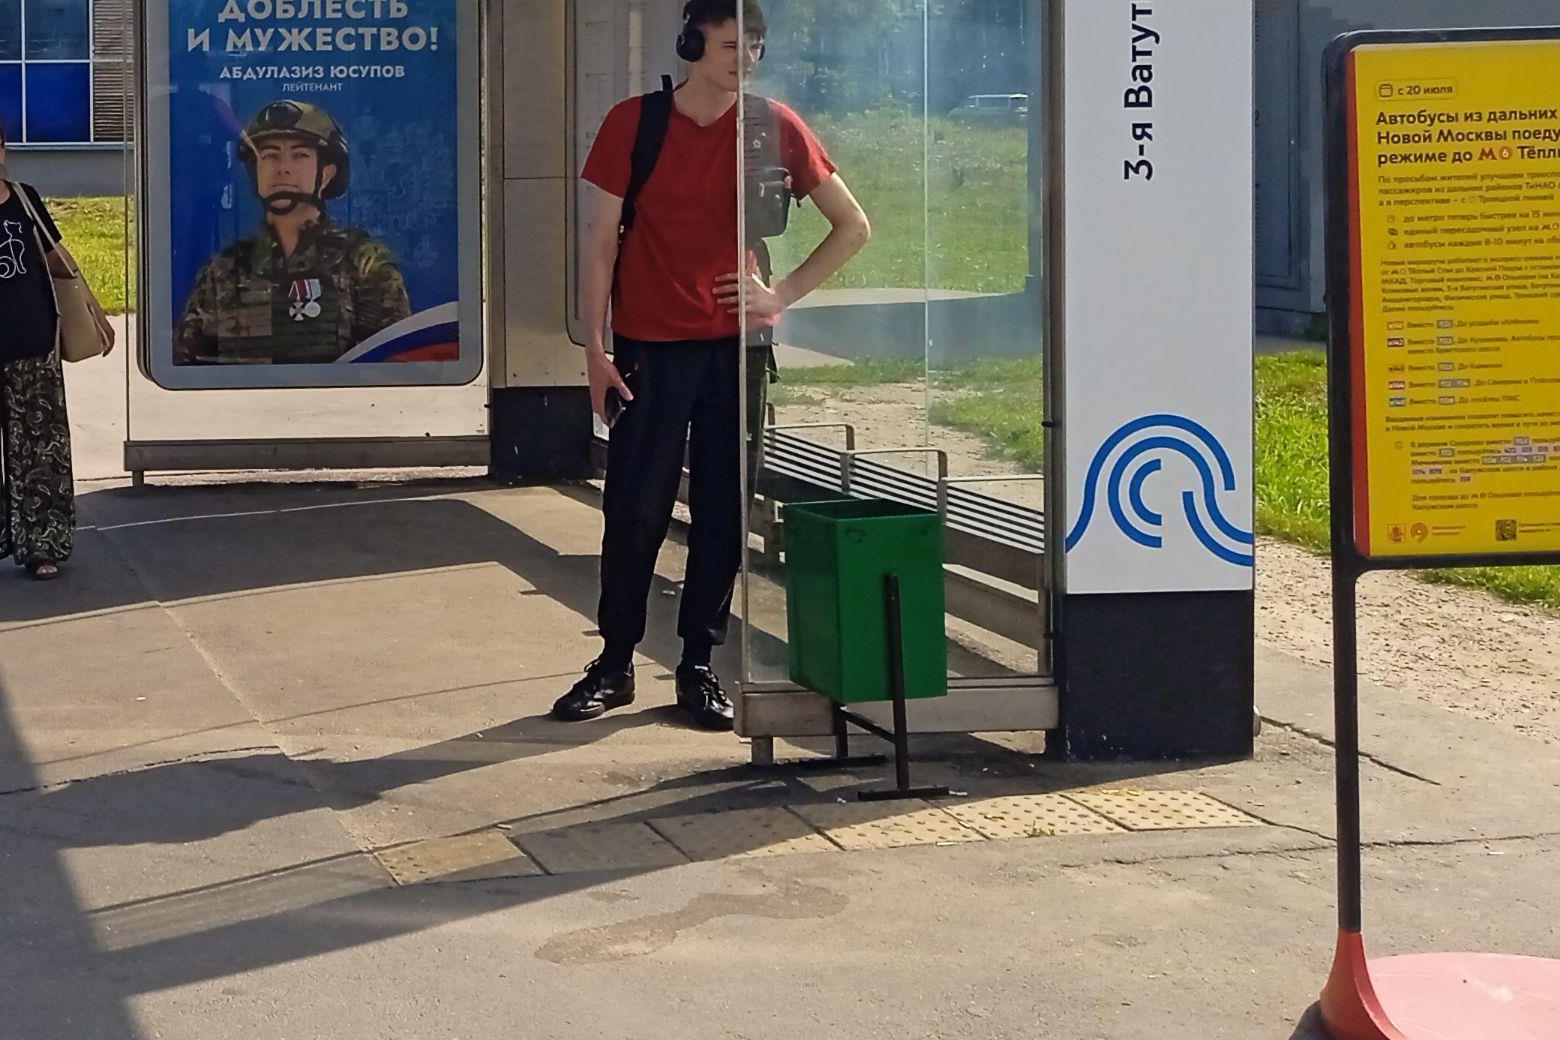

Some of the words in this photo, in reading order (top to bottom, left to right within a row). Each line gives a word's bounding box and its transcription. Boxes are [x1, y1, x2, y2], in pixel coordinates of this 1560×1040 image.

[187, 27, 210, 52] И
[225, 26, 438, 52] МУЖЕСТВО!
[219, 65, 324, 80] АБДУЛАЗИЗ
[330, 64, 406, 78] ЮСУПОВ
[282, 81, 343, 92] ЛЕЙТЕНАНТ
[1397, 87, 1404, 95] с
[1406, 85, 1421, 95] 20
[1423, 85, 1453, 94] июля
[1376, 109, 1459, 127] Автобусы
[1464, 111, 1483, 122] из
[1487, 109, 1558, 123] дальних
[1377, 129, 1433, 145] Новой
[1436, 128, 1507, 143] Москвы
[1123, 121, 1153, 180] 3-я
[1377, 150, 1447, 167] режиме
[1451, 150, 1473, 164] до
